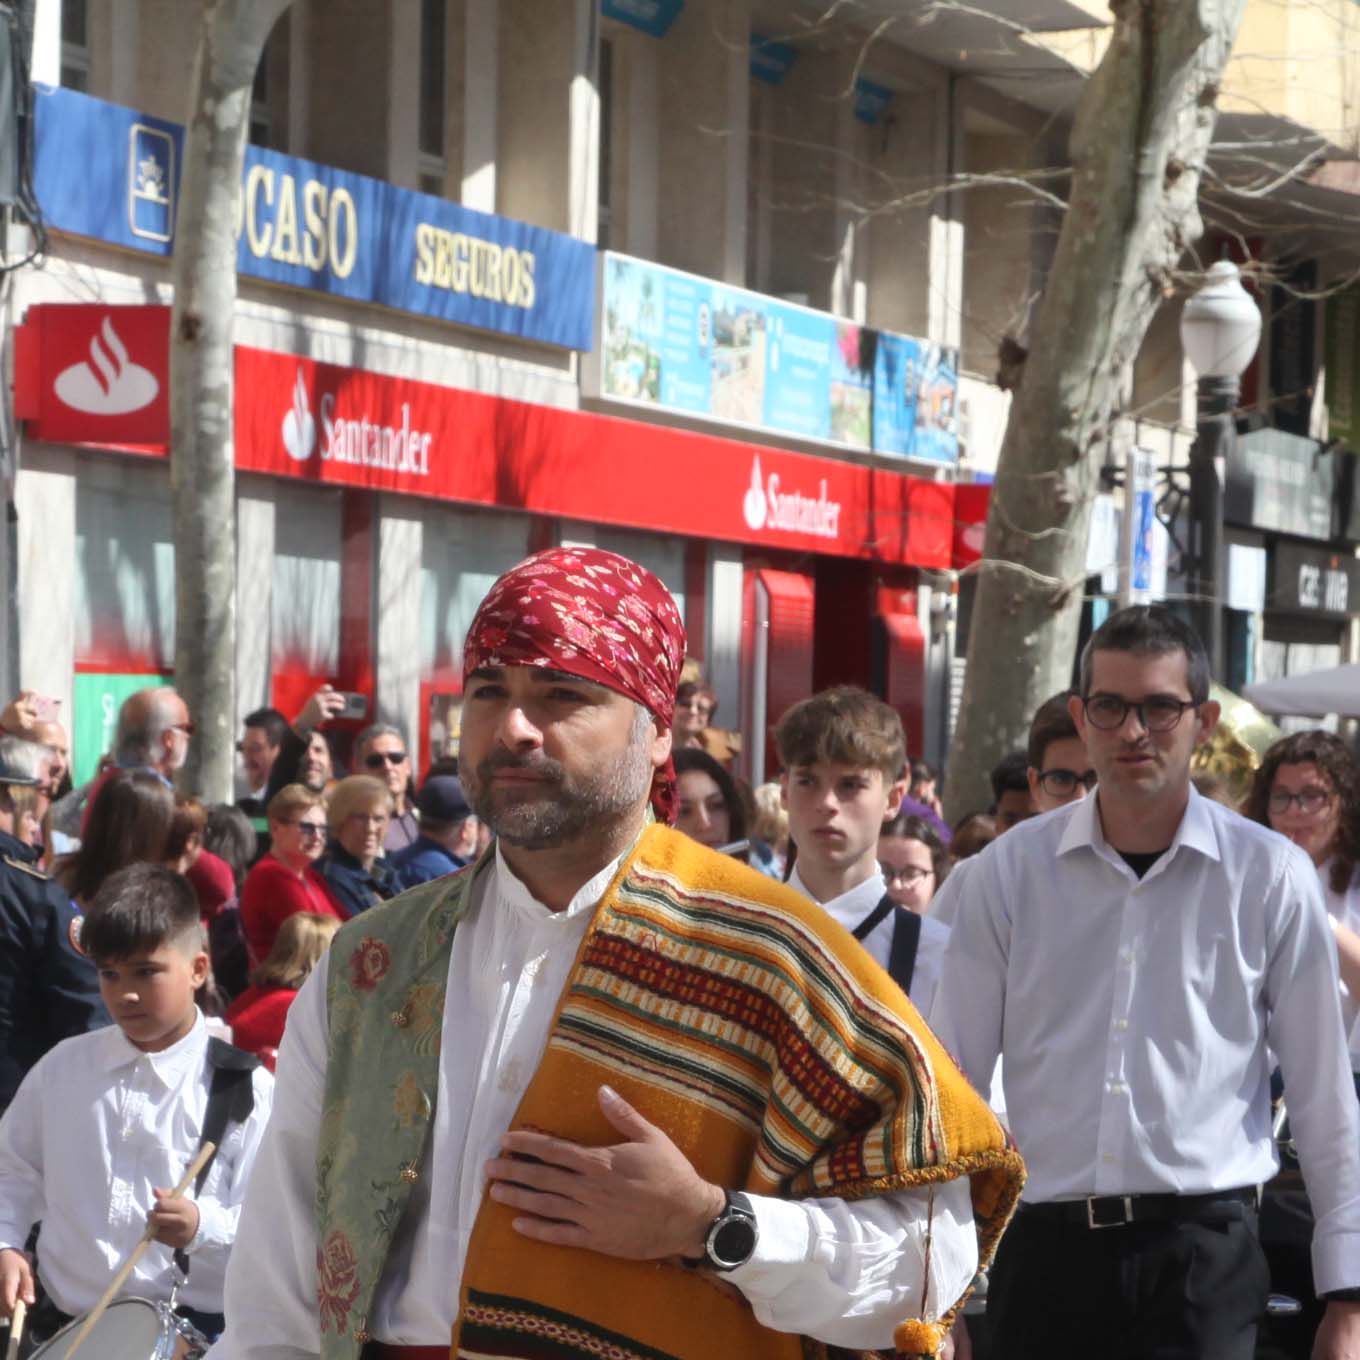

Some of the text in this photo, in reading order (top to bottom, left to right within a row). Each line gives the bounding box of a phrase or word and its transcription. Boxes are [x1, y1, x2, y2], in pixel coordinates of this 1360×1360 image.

[237, 164, 536, 309] CASO SEGUROS
[319, 392, 432, 475] Santander
[767, 472, 841, 539] Santander
